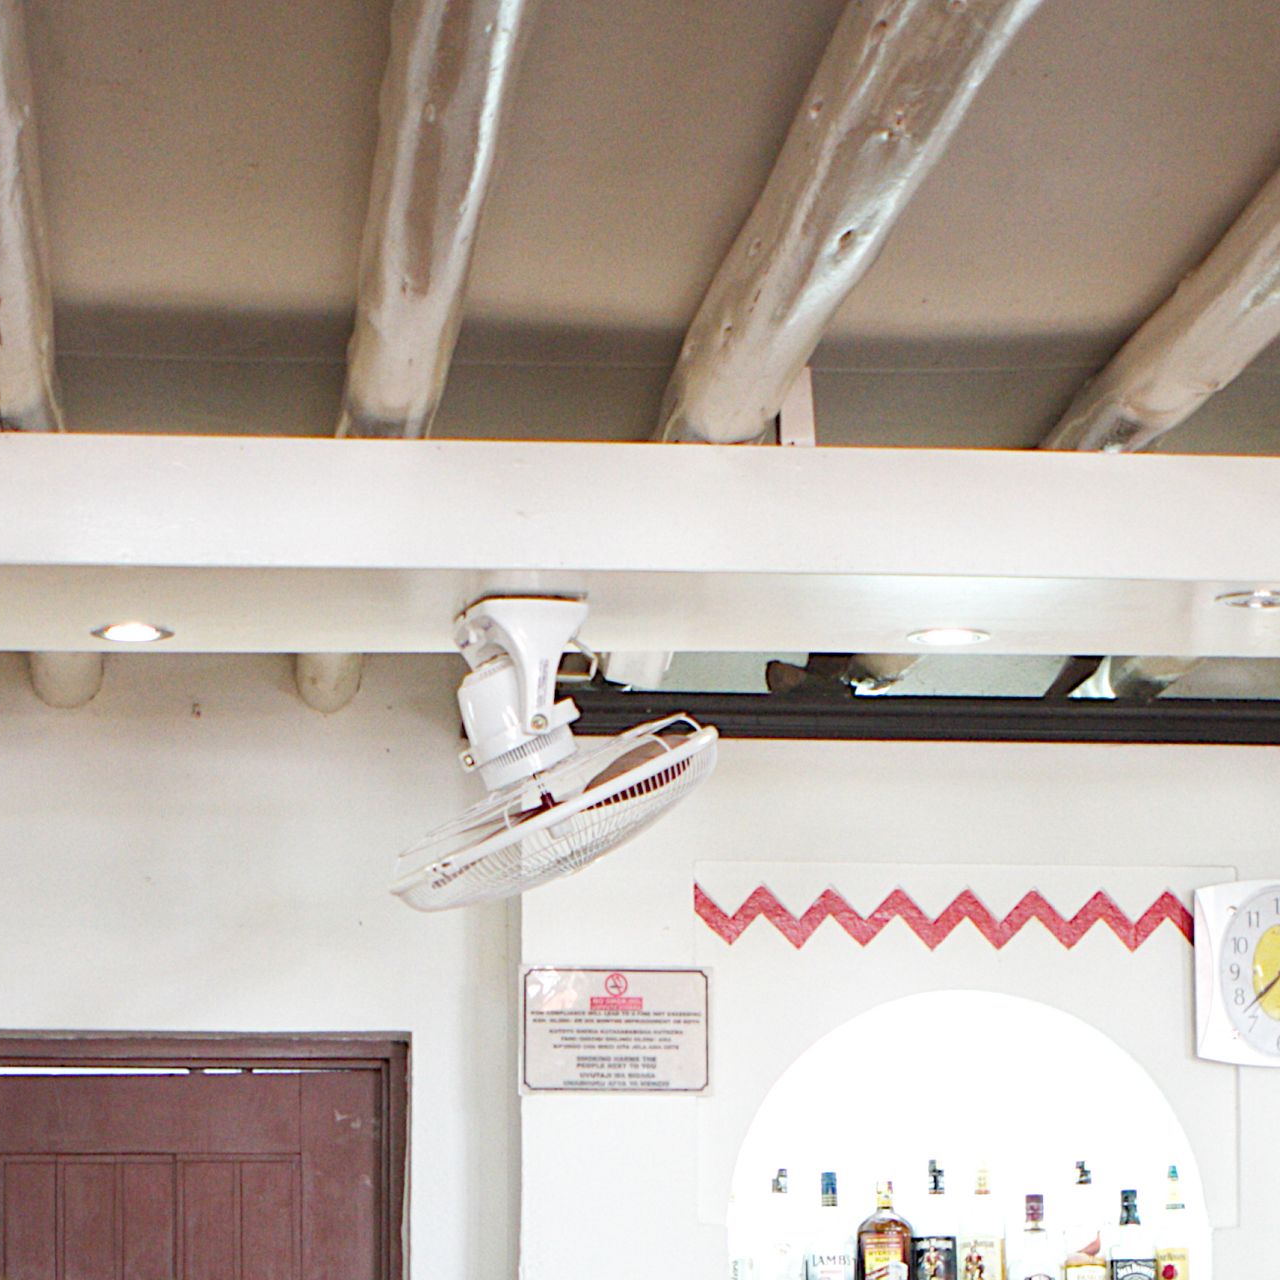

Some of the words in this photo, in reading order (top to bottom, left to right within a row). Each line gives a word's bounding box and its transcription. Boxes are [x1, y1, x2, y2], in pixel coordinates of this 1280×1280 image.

[1247, 911, 1261, 928] 11
[1232, 936, 1249, 955] 10
[1229, 963, 1241, 982] 9
[1233, 987, 1245, 1006] 8
[1247, 1015, 1259, 1033] 7
